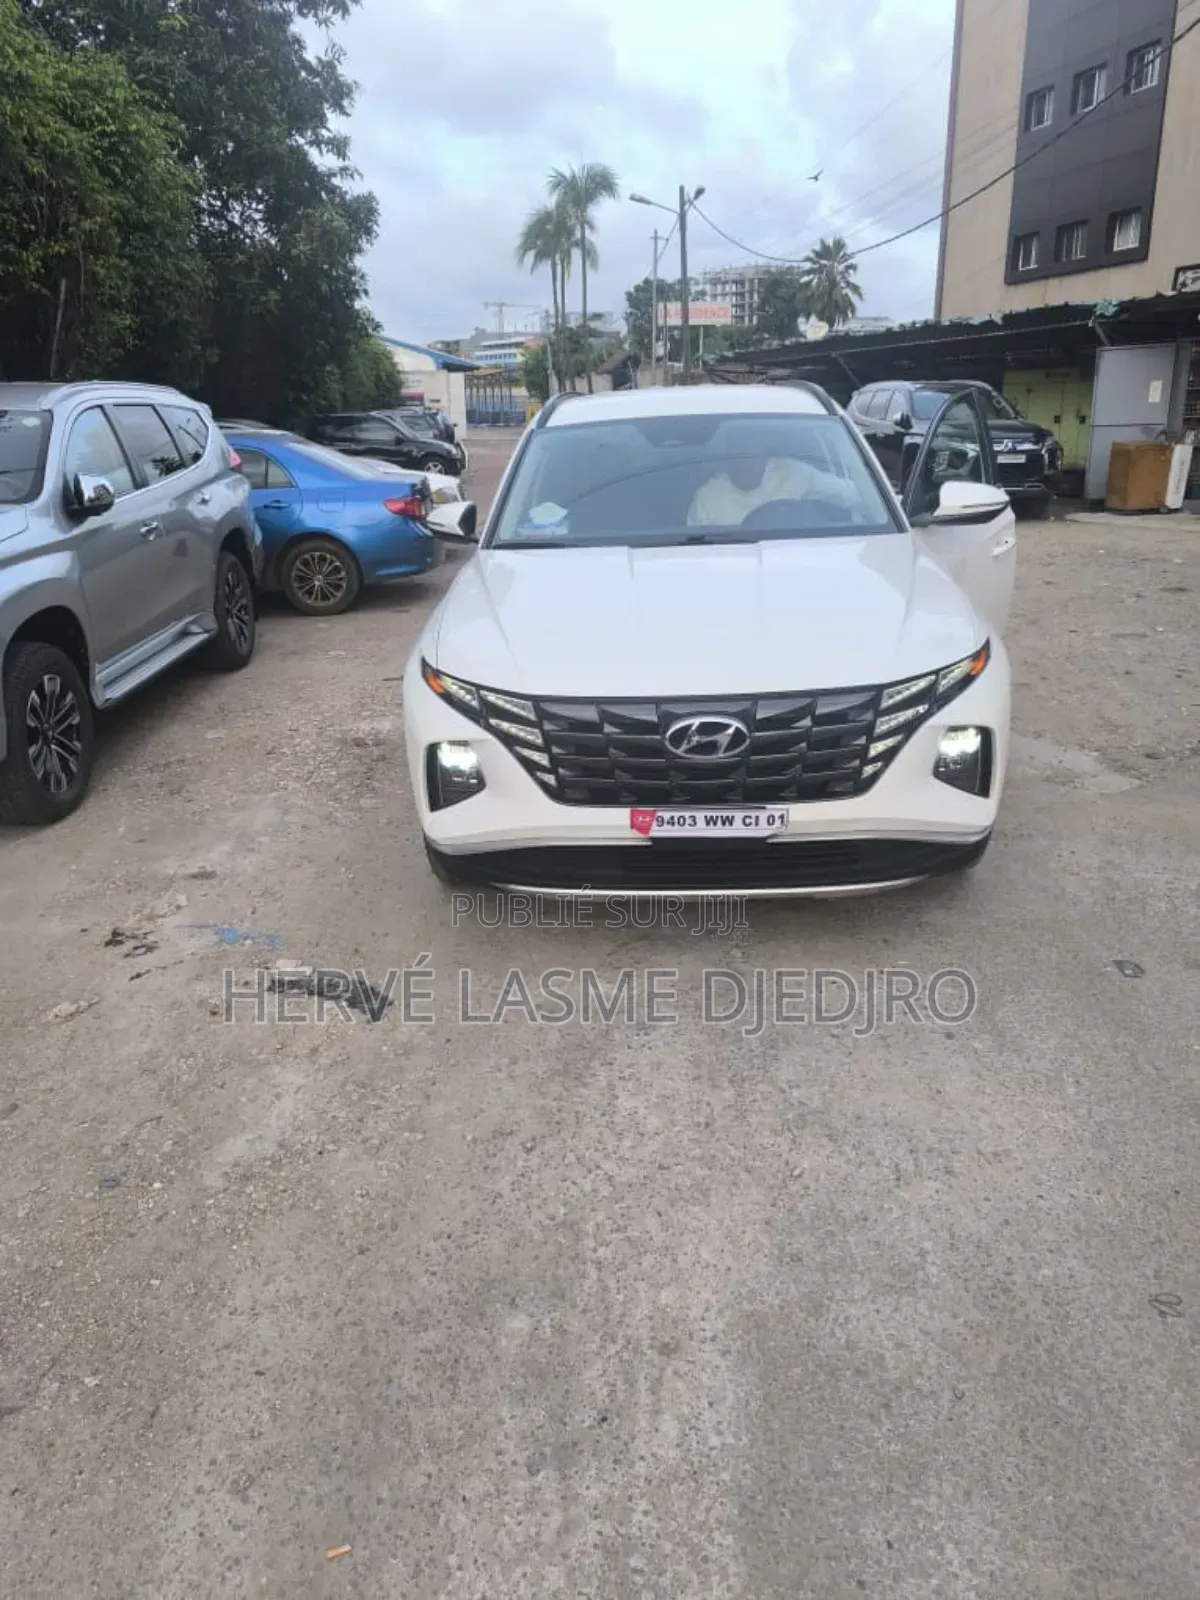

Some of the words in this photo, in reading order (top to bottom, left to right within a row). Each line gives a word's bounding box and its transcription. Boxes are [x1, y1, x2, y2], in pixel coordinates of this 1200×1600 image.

[656, 815, 698, 828] 9403
[704, 815, 735, 828] WW
[742, 814, 760, 827] CI
[766, 814, 786, 827] 01
